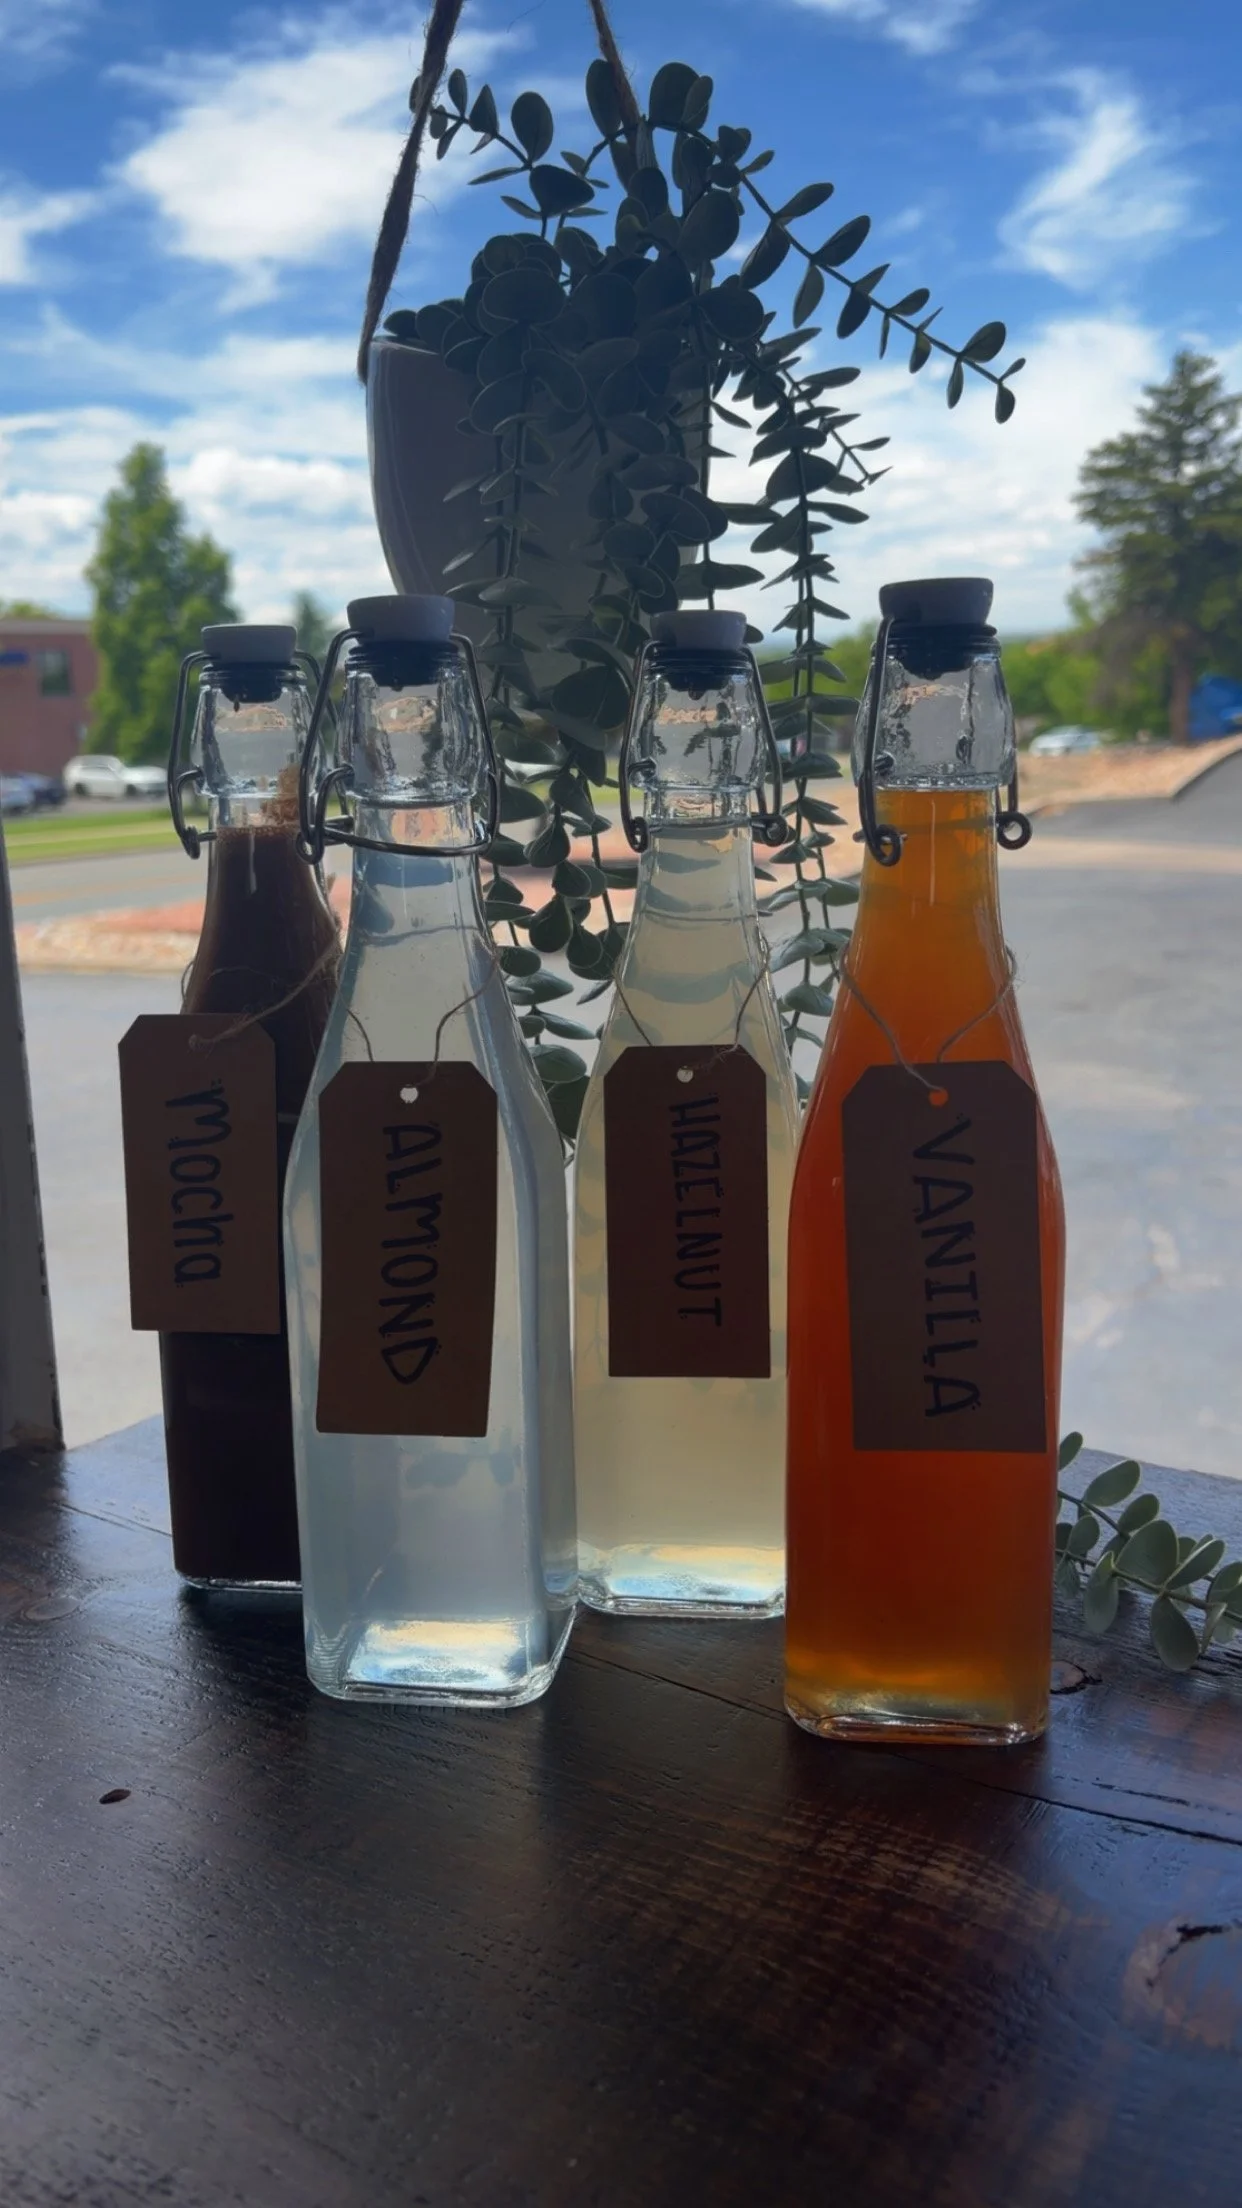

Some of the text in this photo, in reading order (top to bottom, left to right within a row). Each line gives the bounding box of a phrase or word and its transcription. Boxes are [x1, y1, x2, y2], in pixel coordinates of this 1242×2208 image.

[378, 1122, 443, 1385] ALMOND
[668, 1094, 724, 1327] HAZELNUT
[912, 1114, 981, 1417] VANILLA
